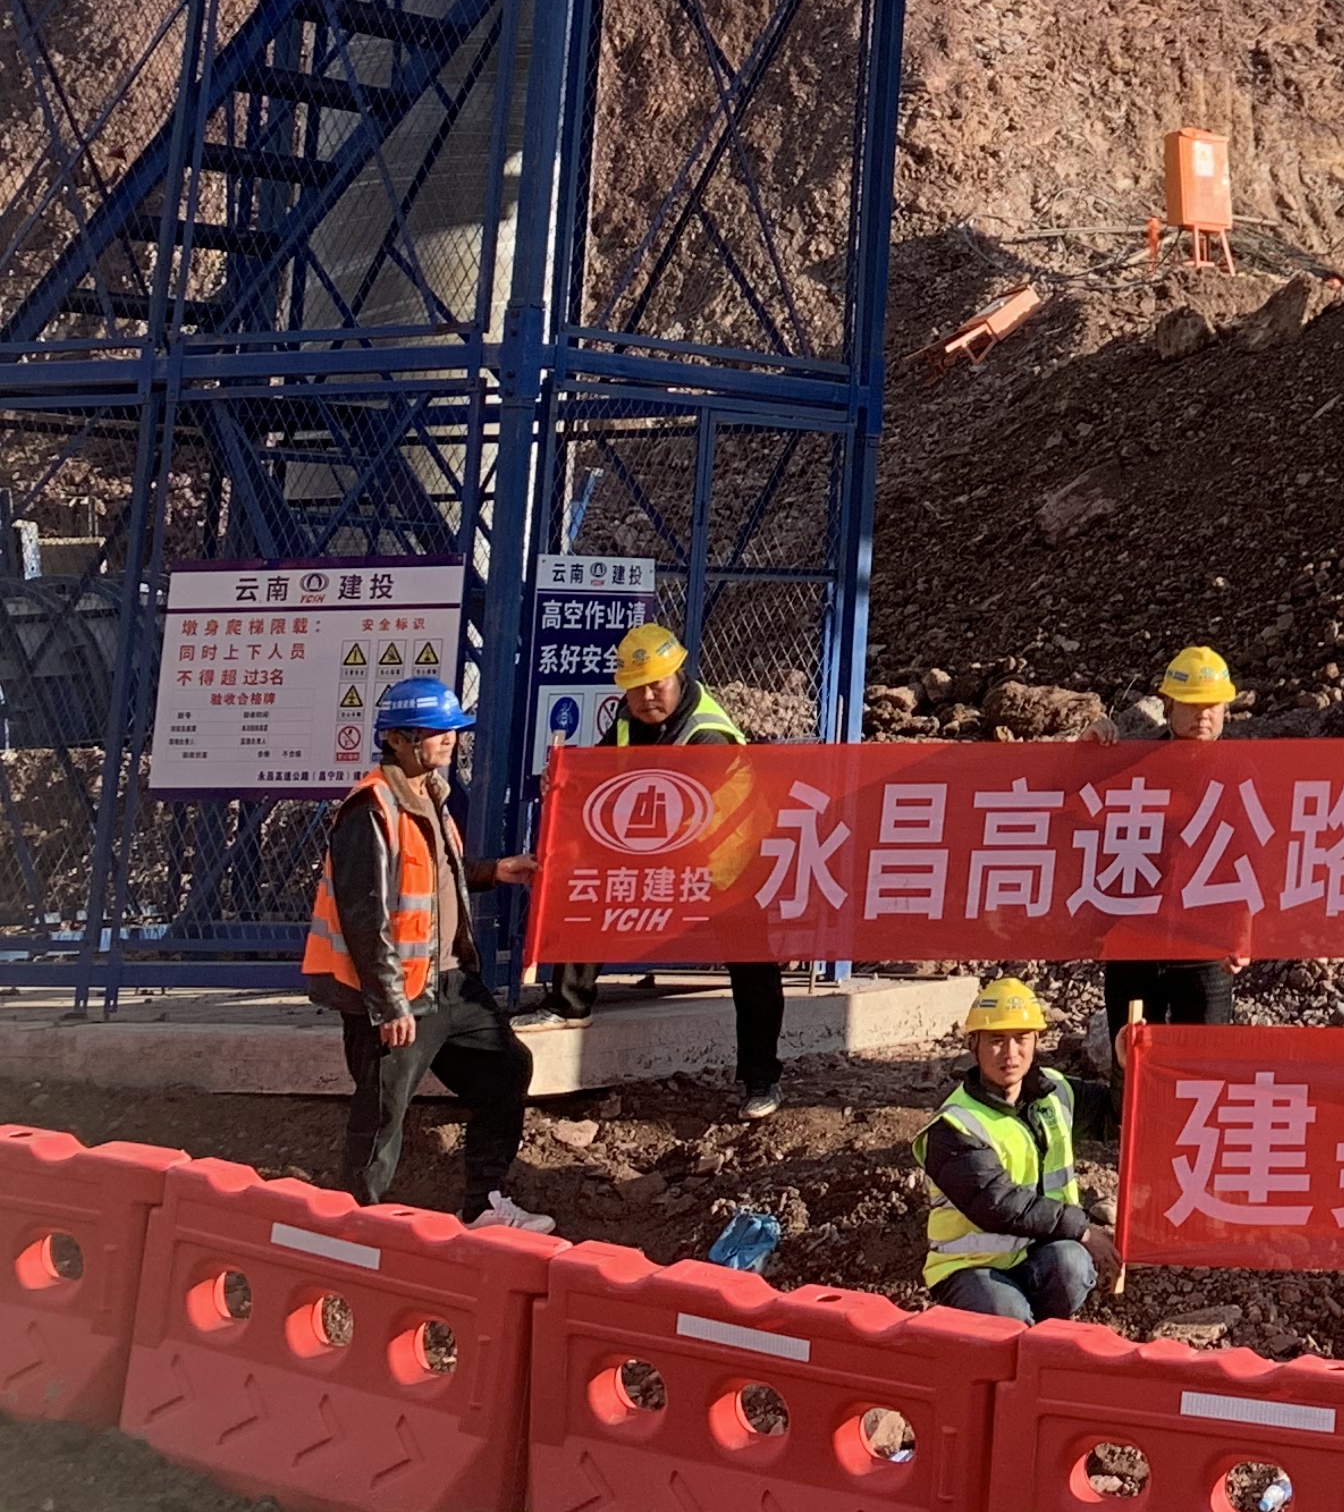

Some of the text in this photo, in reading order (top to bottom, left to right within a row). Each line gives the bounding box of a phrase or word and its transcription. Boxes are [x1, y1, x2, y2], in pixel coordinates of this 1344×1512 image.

[552, 563, 642, 586] 云南 建投
[235, 574, 394, 602] 云南 建投
[361, 617, 425, 632] 安全标识
[541, 599, 646, 630] 高空作业请
[179, 642, 305, 662] 同时上下人员
[176, 668, 284, 687] 不得超过3名
[568, 866, 712, 903] 云南建投
[601, 908, 673, 931] YCIH
